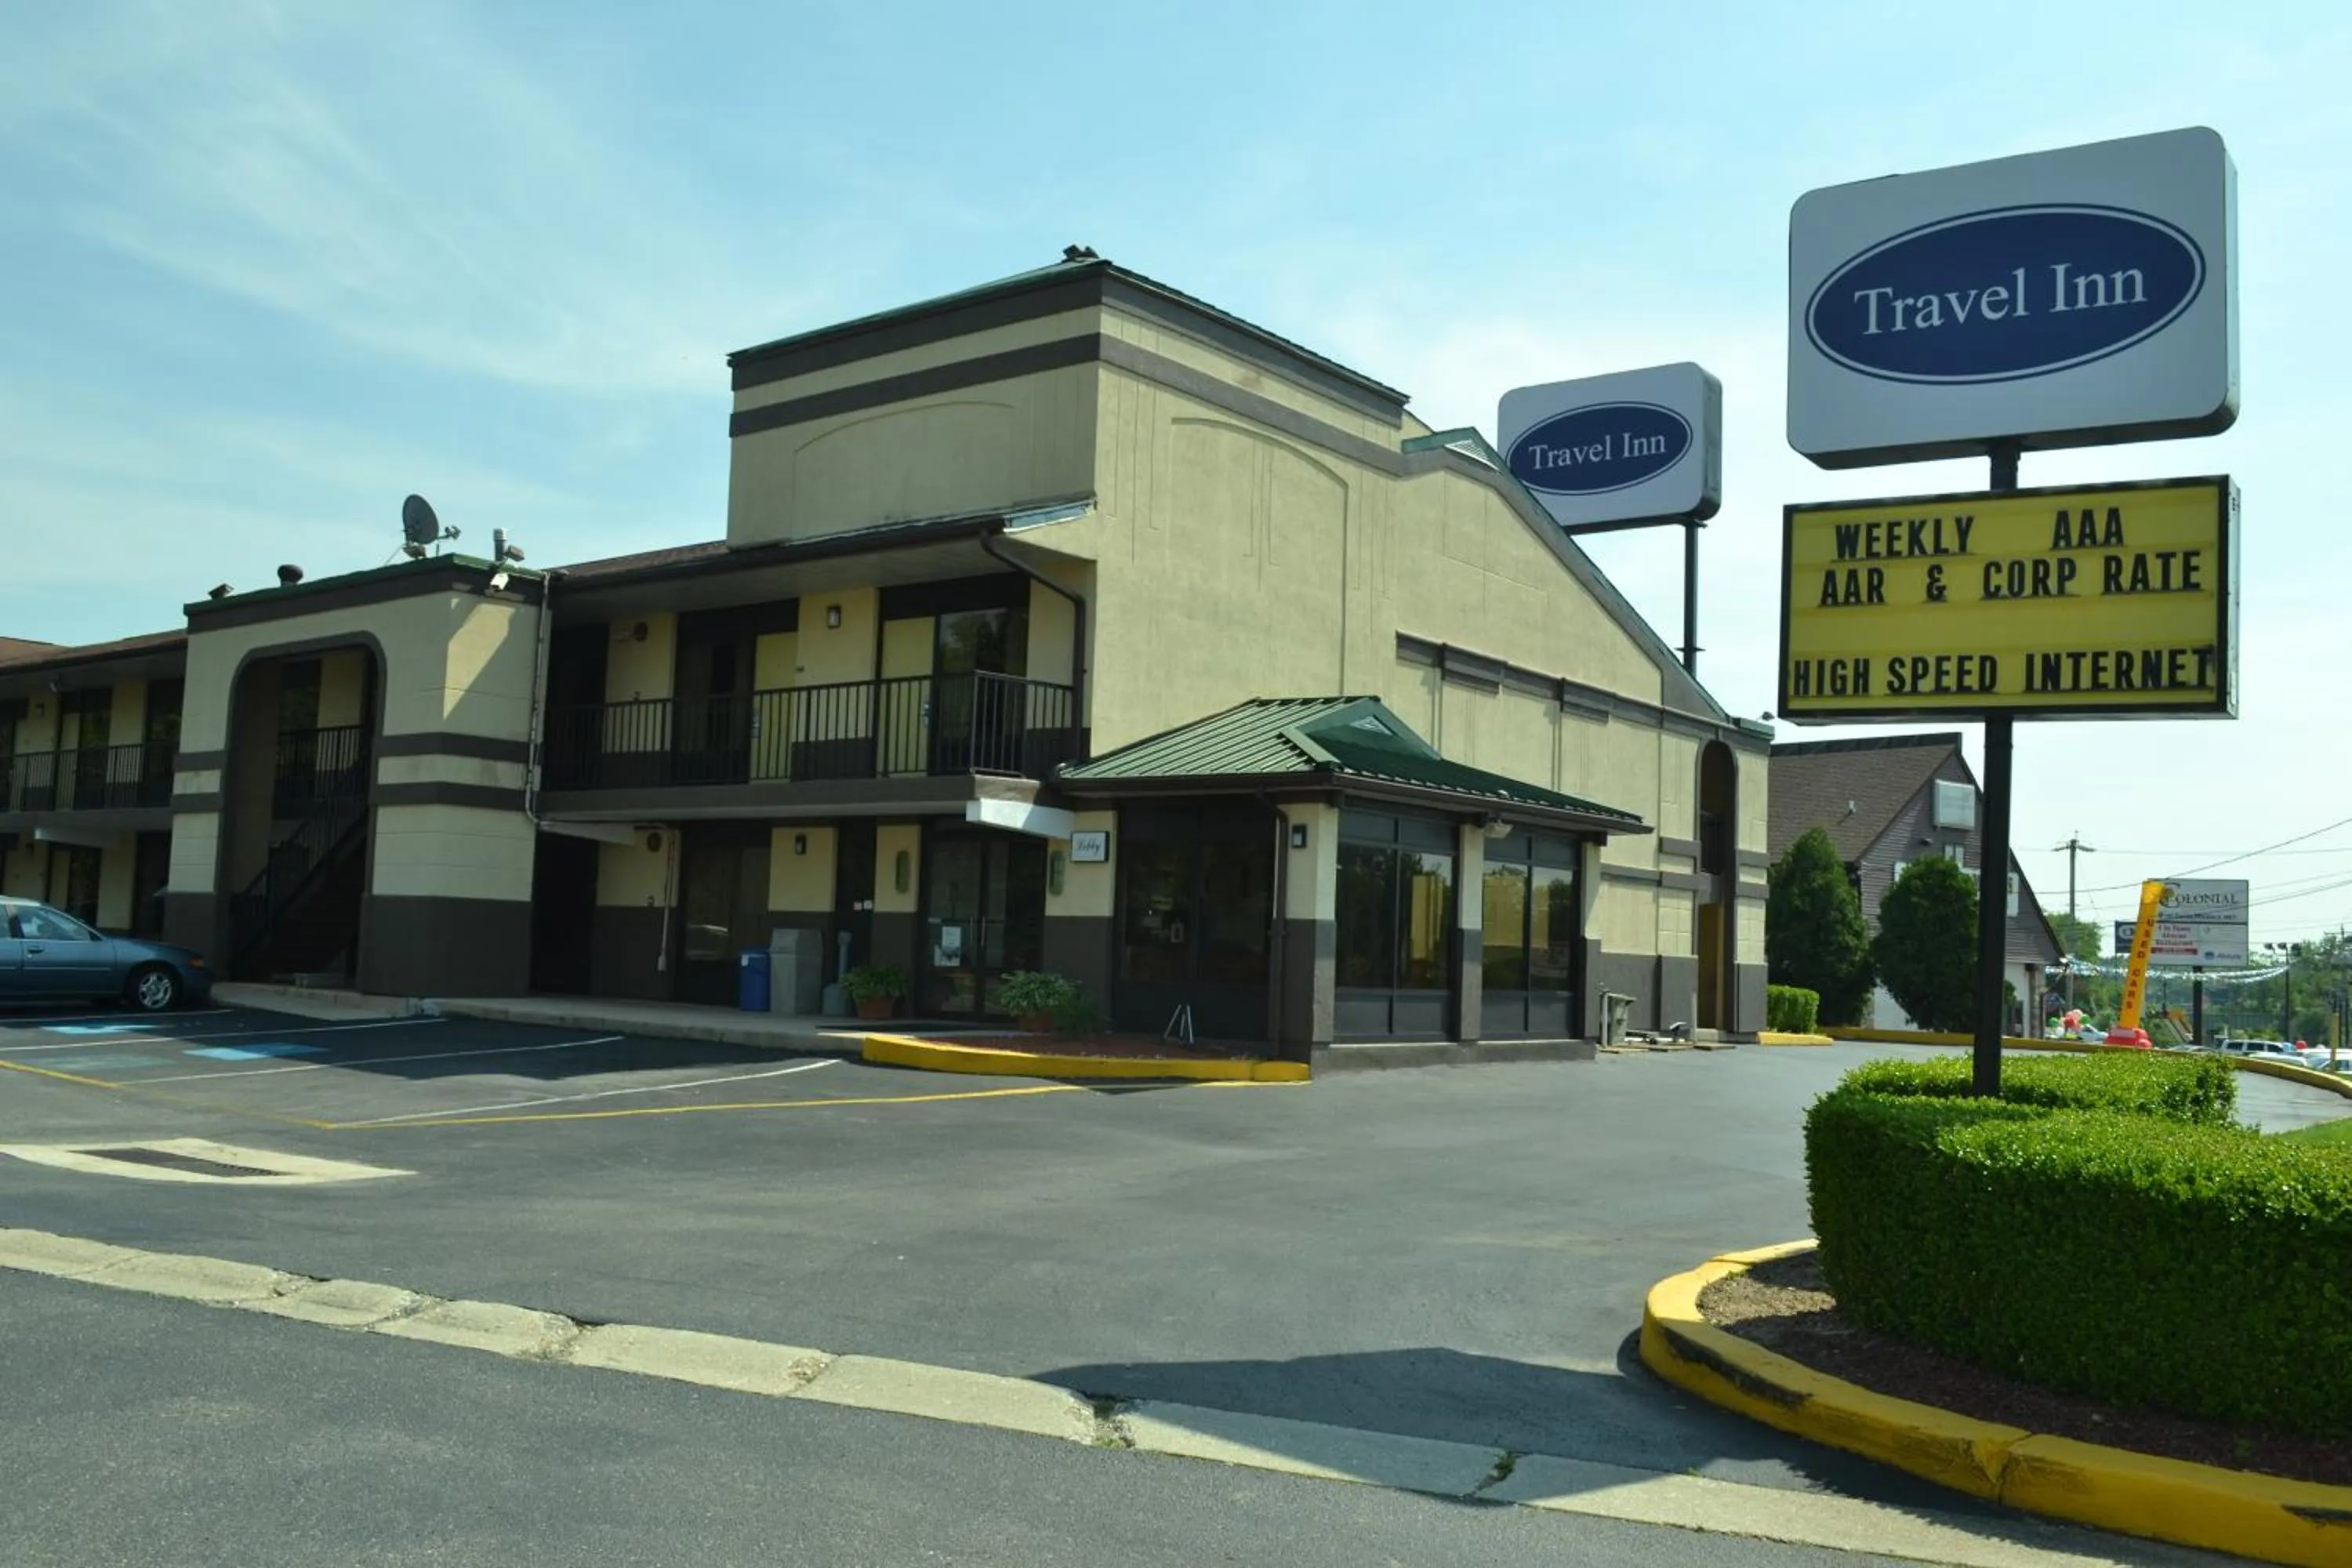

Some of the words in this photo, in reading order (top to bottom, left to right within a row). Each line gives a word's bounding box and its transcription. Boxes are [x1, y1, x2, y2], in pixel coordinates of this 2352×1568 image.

[1854, 268, 2030, 336] Travel
[2049, 262, 2147, 314] Inn
[1529, 435, 1611, 470] Travel
[1622, 431, 1666, 458] Inn
[1835, 516, 1975, 559] WEEKLY
[2052, 507, 2124, 549] AAA
[1820, 568, 1885, 604] AAR
[1926, 564, 1947, 601] &
[1982, 559, 2077, 597] CORP
[2103, 551, 2201, 591] RATE
[1794, 659, 1871, 696] HIGH
[1886, 655, 1998, 695] SPEED
[2024, 648, 2214, 691] INTERNET
